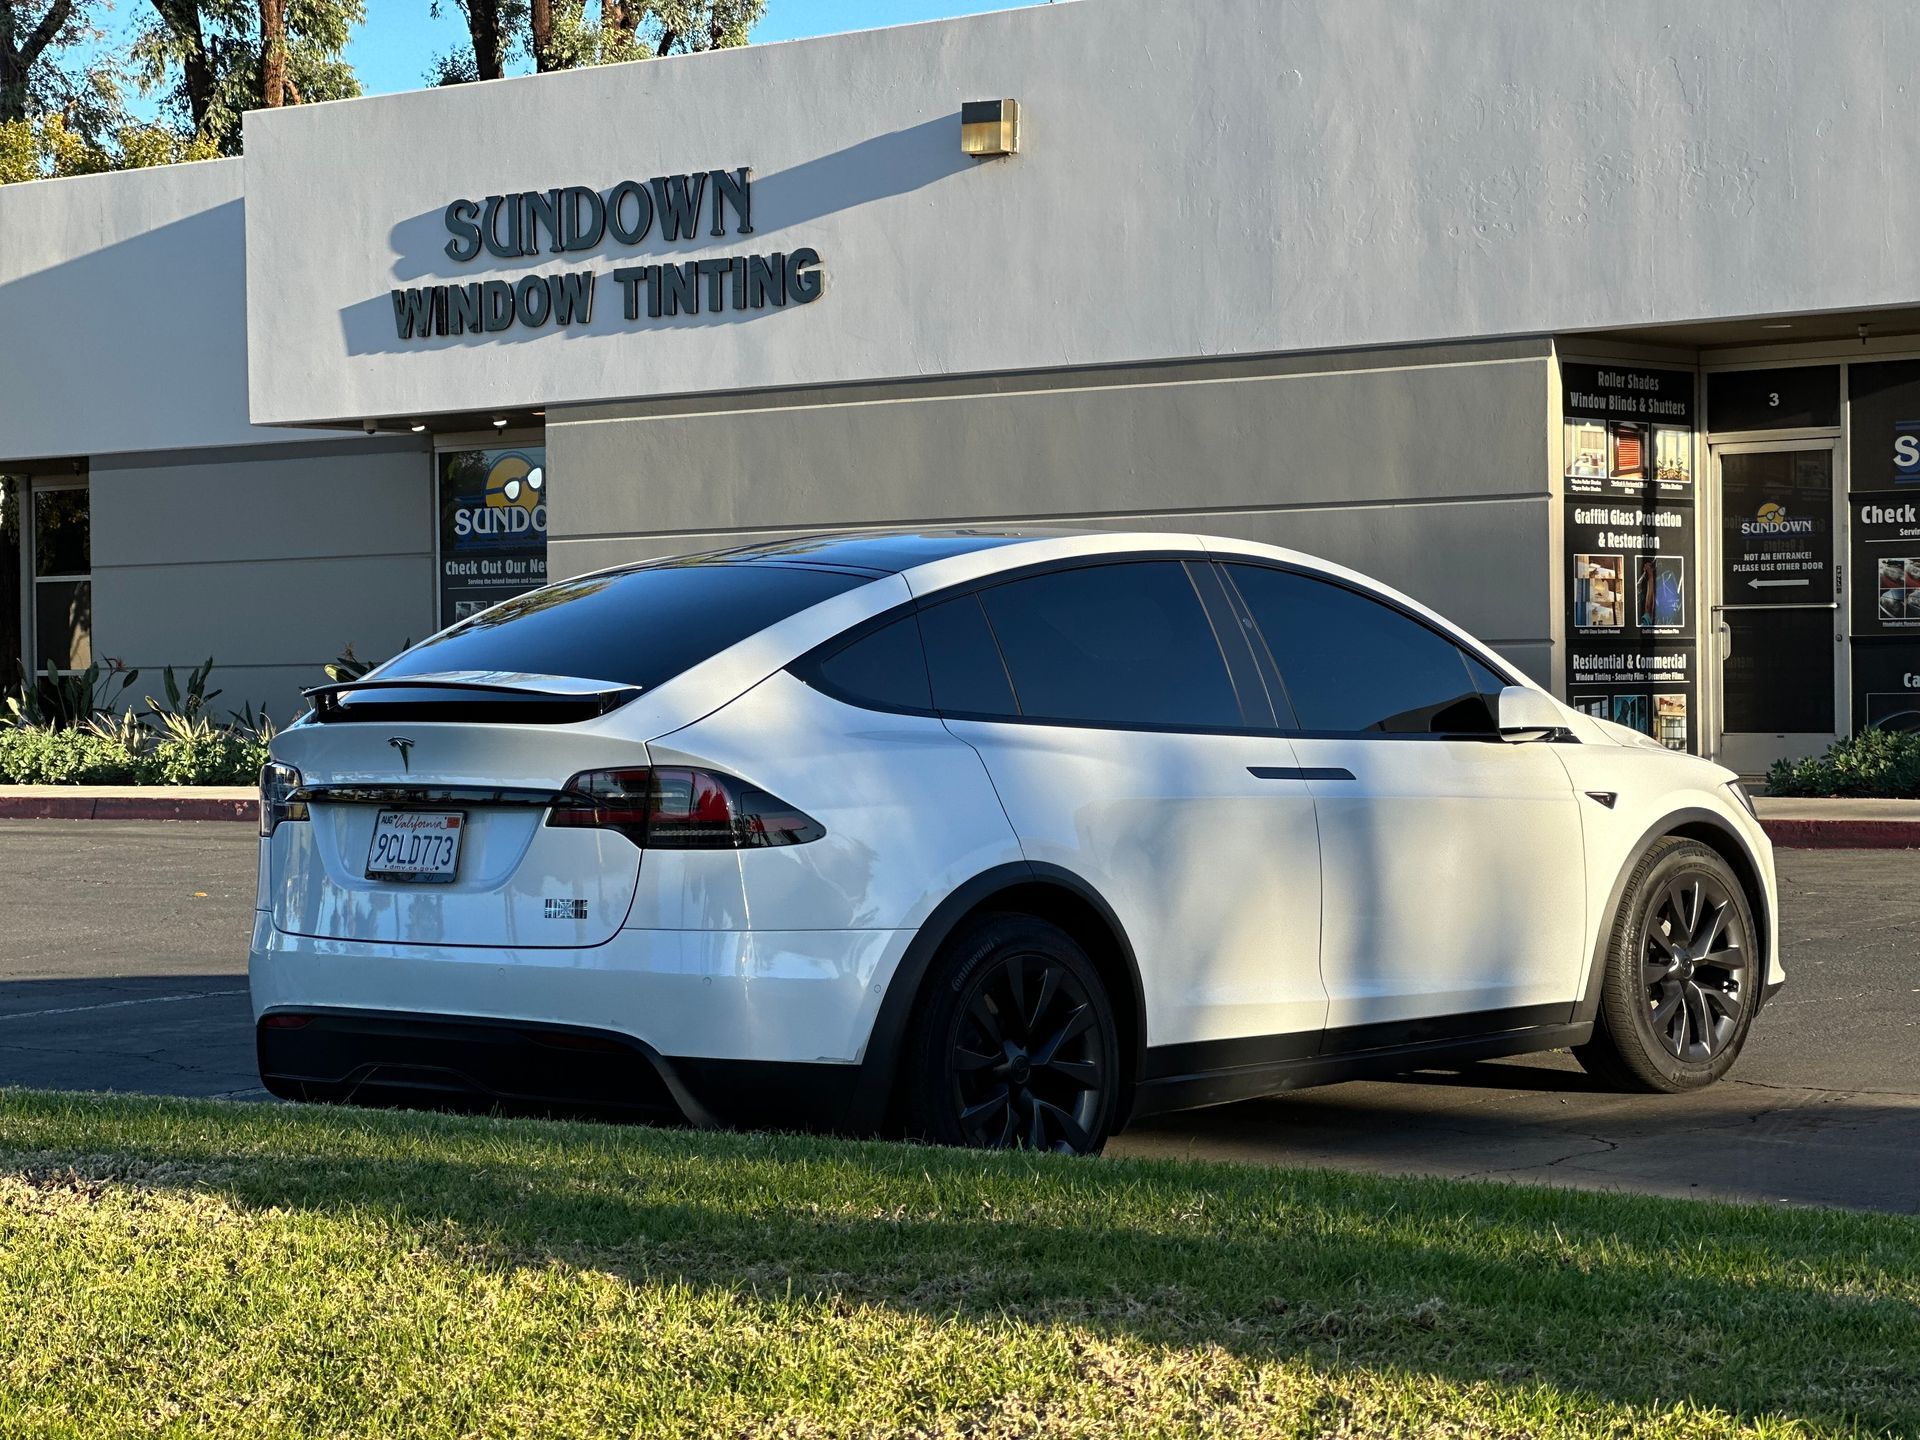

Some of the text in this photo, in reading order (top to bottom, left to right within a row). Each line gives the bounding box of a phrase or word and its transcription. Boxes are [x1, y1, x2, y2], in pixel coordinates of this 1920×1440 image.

[444, 166, 754, 262] SUNDOWN
[391, 248, 826, 339] WINDOW TINTING
[1598, 371, 1659, 391] Roller Shades
[1570, 391, 1686, 415] Window Blinds & Shutters
[1769, 392, 1780, 407] 3
[1574, 508, 1682, 528] Graffiti Glass Protection
[1861, 504, 1916, 524] Check
[1741, 520, 1812, 534] SUNDOWN
[1598, 531, 1660, 549] & Restoration
[1744, 551, 1812, 561] NOT AN ENTRANCE!
[445, 558, 547, 576] Check Out Our Ne
[1733, 561, 1824, 572] PLEASE USE OTHER DOOR
[1572, 653, 1687, 670] Residential & Commercial
[1575, 672, 1594, 681] Window
[1594, 672, 1612, 682] Tinting
[1615, 672, 1633, 681] Security
[1634, 672, 1644, 680] Film
[1671, 671, 1685, 680] Films
[382, 816, 393, 825] AUG
[394, 814, 447, 833] California
[374, 833, 454, 866] 9CLD773
